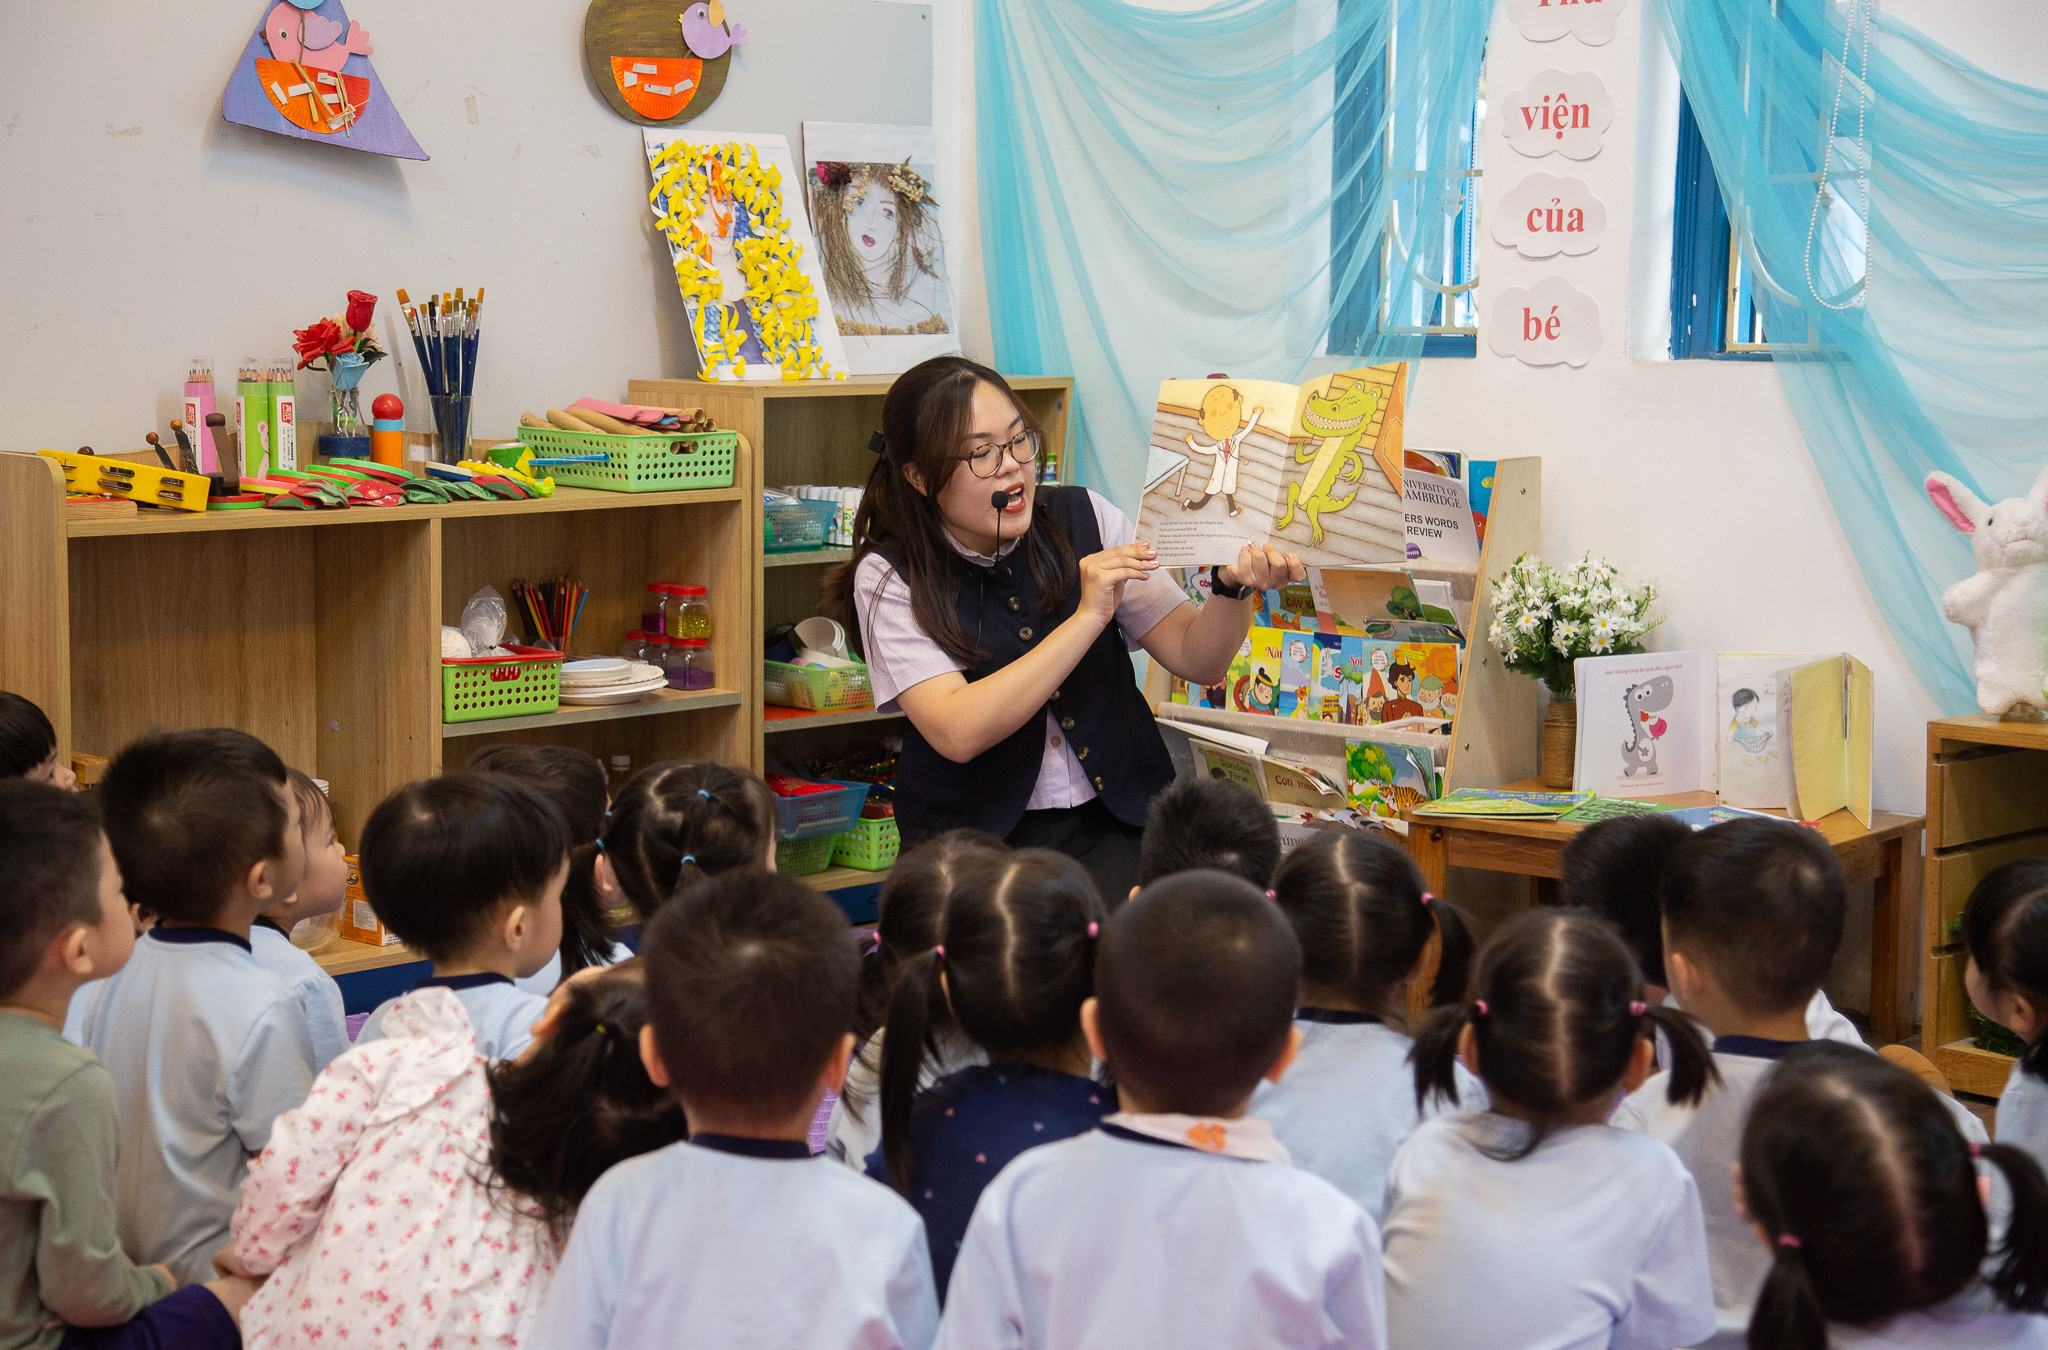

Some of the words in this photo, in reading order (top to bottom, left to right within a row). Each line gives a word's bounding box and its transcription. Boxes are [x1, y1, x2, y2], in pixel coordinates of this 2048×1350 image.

[1520, 93, 1590, 140] viện
[1526, 197, 1585, 233] của
[1522, 305, 1561, 341] bé
[1403, 479, 1446, 495] NIVERSITY
[1446, 487, 1458, 498] OF
[1404, 489, 1462, 509] AMBRIDGE
[1404, 513, 1423, 525] ERS
[1424, 515, 1459, 530] WORDS
[1406, 525, 1443, 539] REVIEW
[1274, 774, 1294, 788] Con
